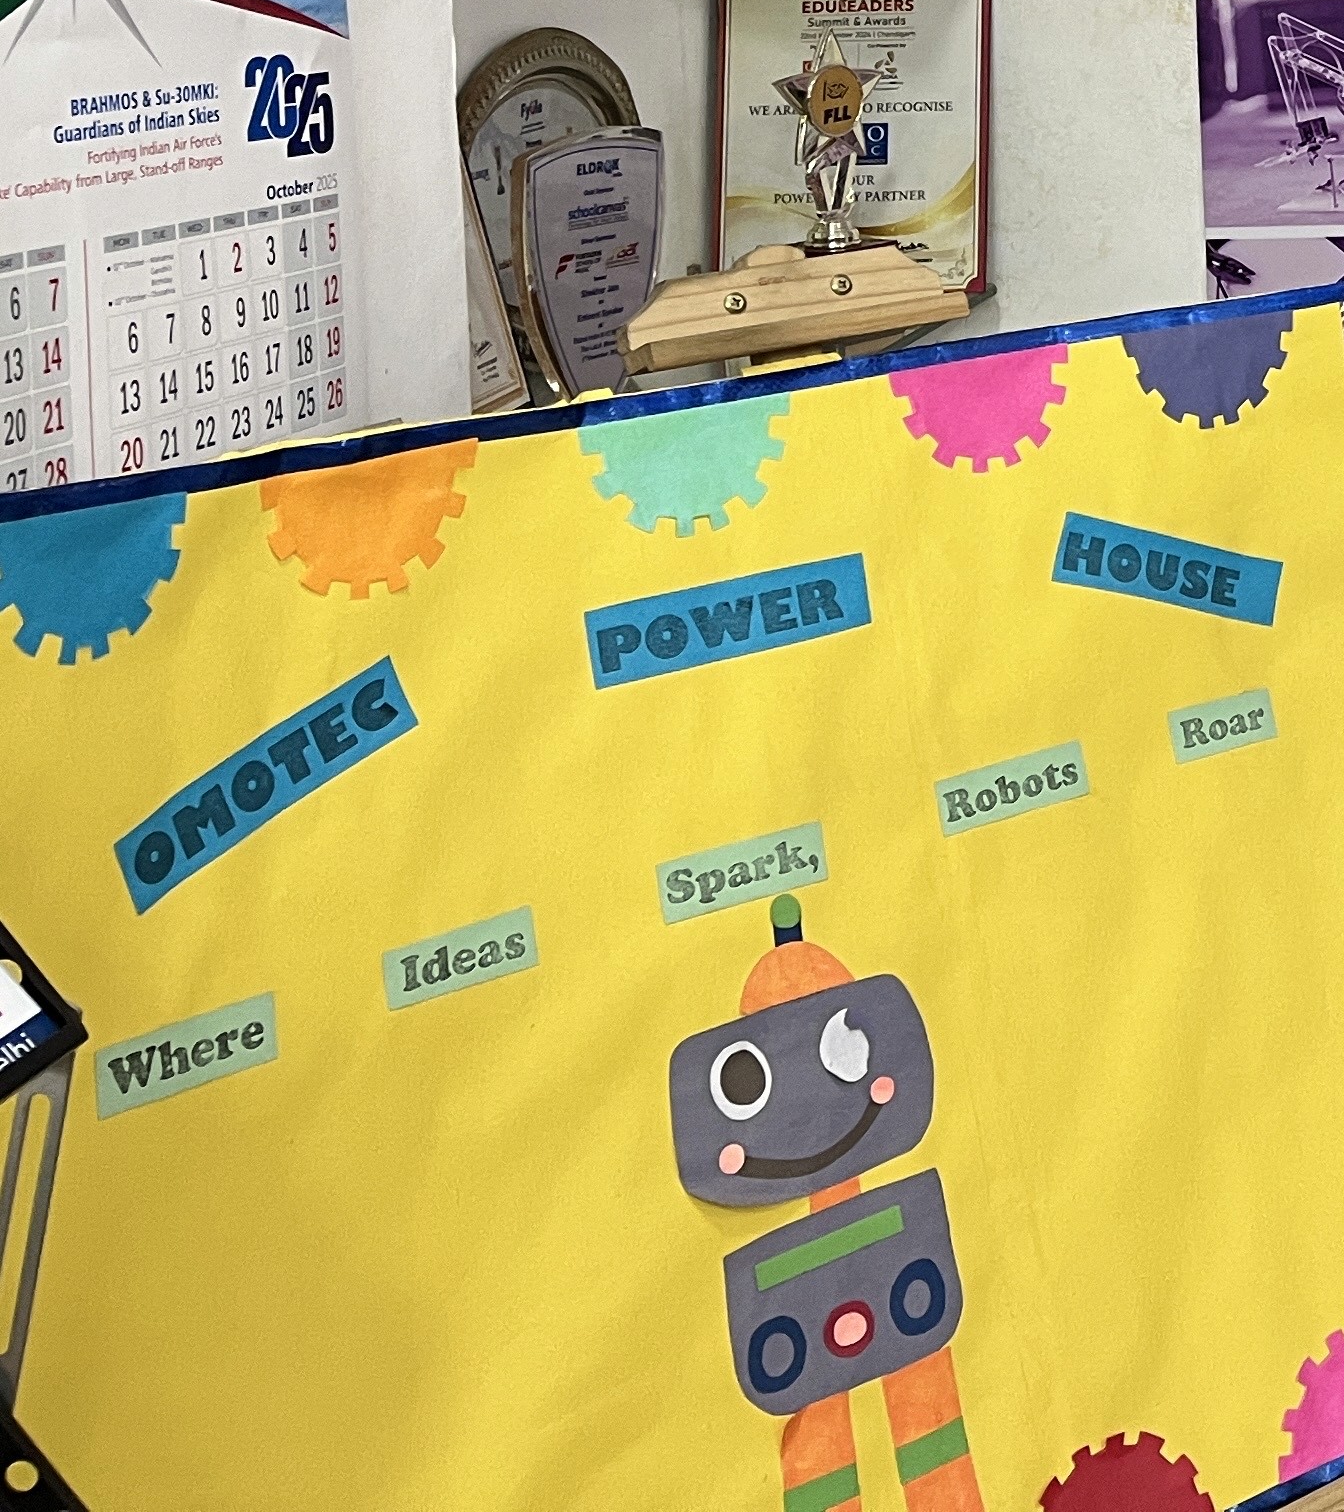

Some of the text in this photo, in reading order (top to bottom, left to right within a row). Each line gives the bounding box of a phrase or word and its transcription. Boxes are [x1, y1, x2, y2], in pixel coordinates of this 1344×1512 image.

[807, 17, 850, 28] Summit
[864, 16, 906, 26] Awards
[70, 82, 219, 117] BRAHMOS & Su-30MKI:
[245, 54, 335, 158] 2025
[748, 105, 770, 116] WE
[876, 101, 954, 114] RECOGNISE
[823, 106, 852, 125] FLL
[53, 107, 220, 144] Guardians of Indian Skies
[14, 176, 73, 199] Capability
[76, 173, 102, 189] from
[140, 157, 186, 179] Stand-off
[188, 153, 224, 172] Ranges
[87, 145, 137, 166] Fortifying
[139, 140, 171, 158] Indian
[172, 137, 187, 152] Air
[266, 172, 338, 201] October 2025
[864, 190, 926, 202] PARTNER
[199, 249, 208, 280] 1
[232, 241, 243, 274] 2
[265, 235, 277, 266] 3
[298, 227, 308, 257] 4
[328, 222, 337, 252] 5
[9, 277, 60, 321] 6 7
[127, 273, 340, 354] 6 7 8 9 10 11 12
[3, 336, 62, 385] 13 14
[119, 325, 341, 416] 13 14 15 16 17 18 19
[3, 396, 65, 447] 20 21
[120, 377, 343, 473] 20 21 22 23 24 25 26
[45, 456, 68, 486] 28
[1060, 531, 1238, 610] HOUSE
[596, 578, 845, 681] POWER
[1180, 702, 1266, 751] Roar
[133, 676, 400, 887] OMOTEC
[941, 758, 1079, 824] Robots
[664, 845, 822, 906] Spark,
[399, 928, 526, 994] Ideas
[107, 1020, 267, 1097] Where
